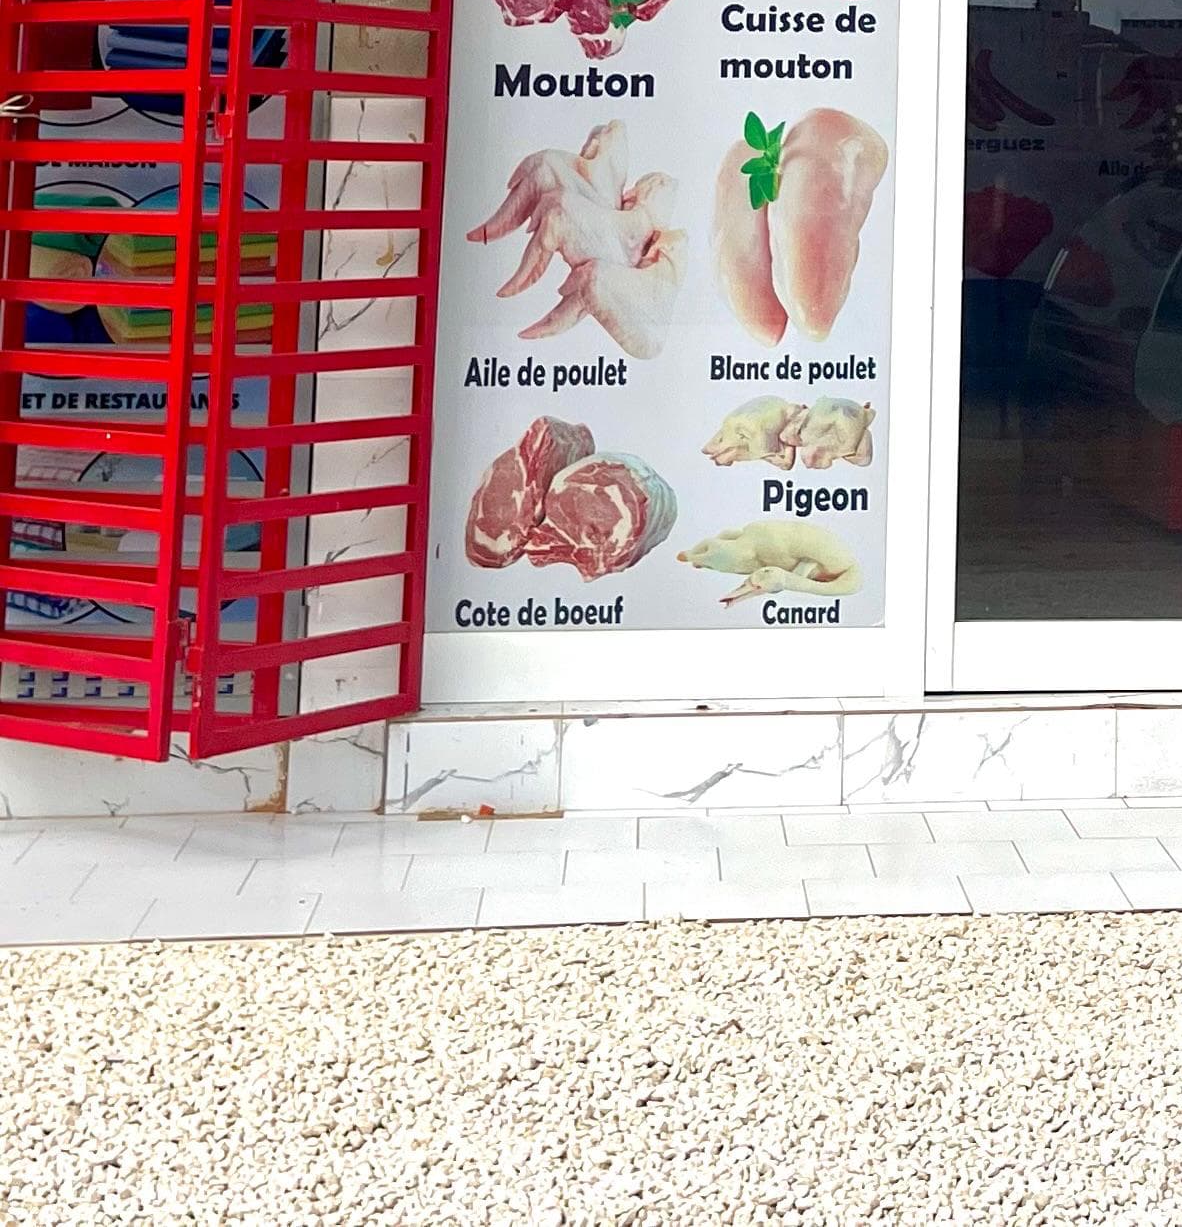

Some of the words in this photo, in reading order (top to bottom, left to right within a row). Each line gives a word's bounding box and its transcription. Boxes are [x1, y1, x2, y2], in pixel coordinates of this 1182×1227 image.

[721, 4, 825, 34] Cuisse
[835, 5, 876, 34] de
[494, 63, 655, 99] Mouton
[720, 54, 852, 80] mouton
[464, 357, 510, 388] Aile
[517, 357, 546, 387] de
[552, 358, 627, 392] poulet
[710, 354, 770, 381] Blanc
[777, 356, 802, 381] de
[808, 355, 876, 384] poulet
[52, 393, 78, 409] DE
[762, 479, 869, 517] Pigeon
[455, 599, 511, 627] Cote
[517, 598, 548, 626] de
[554, 595, 624, 625] boeuf
[762, 599, 840, 625] Canard
